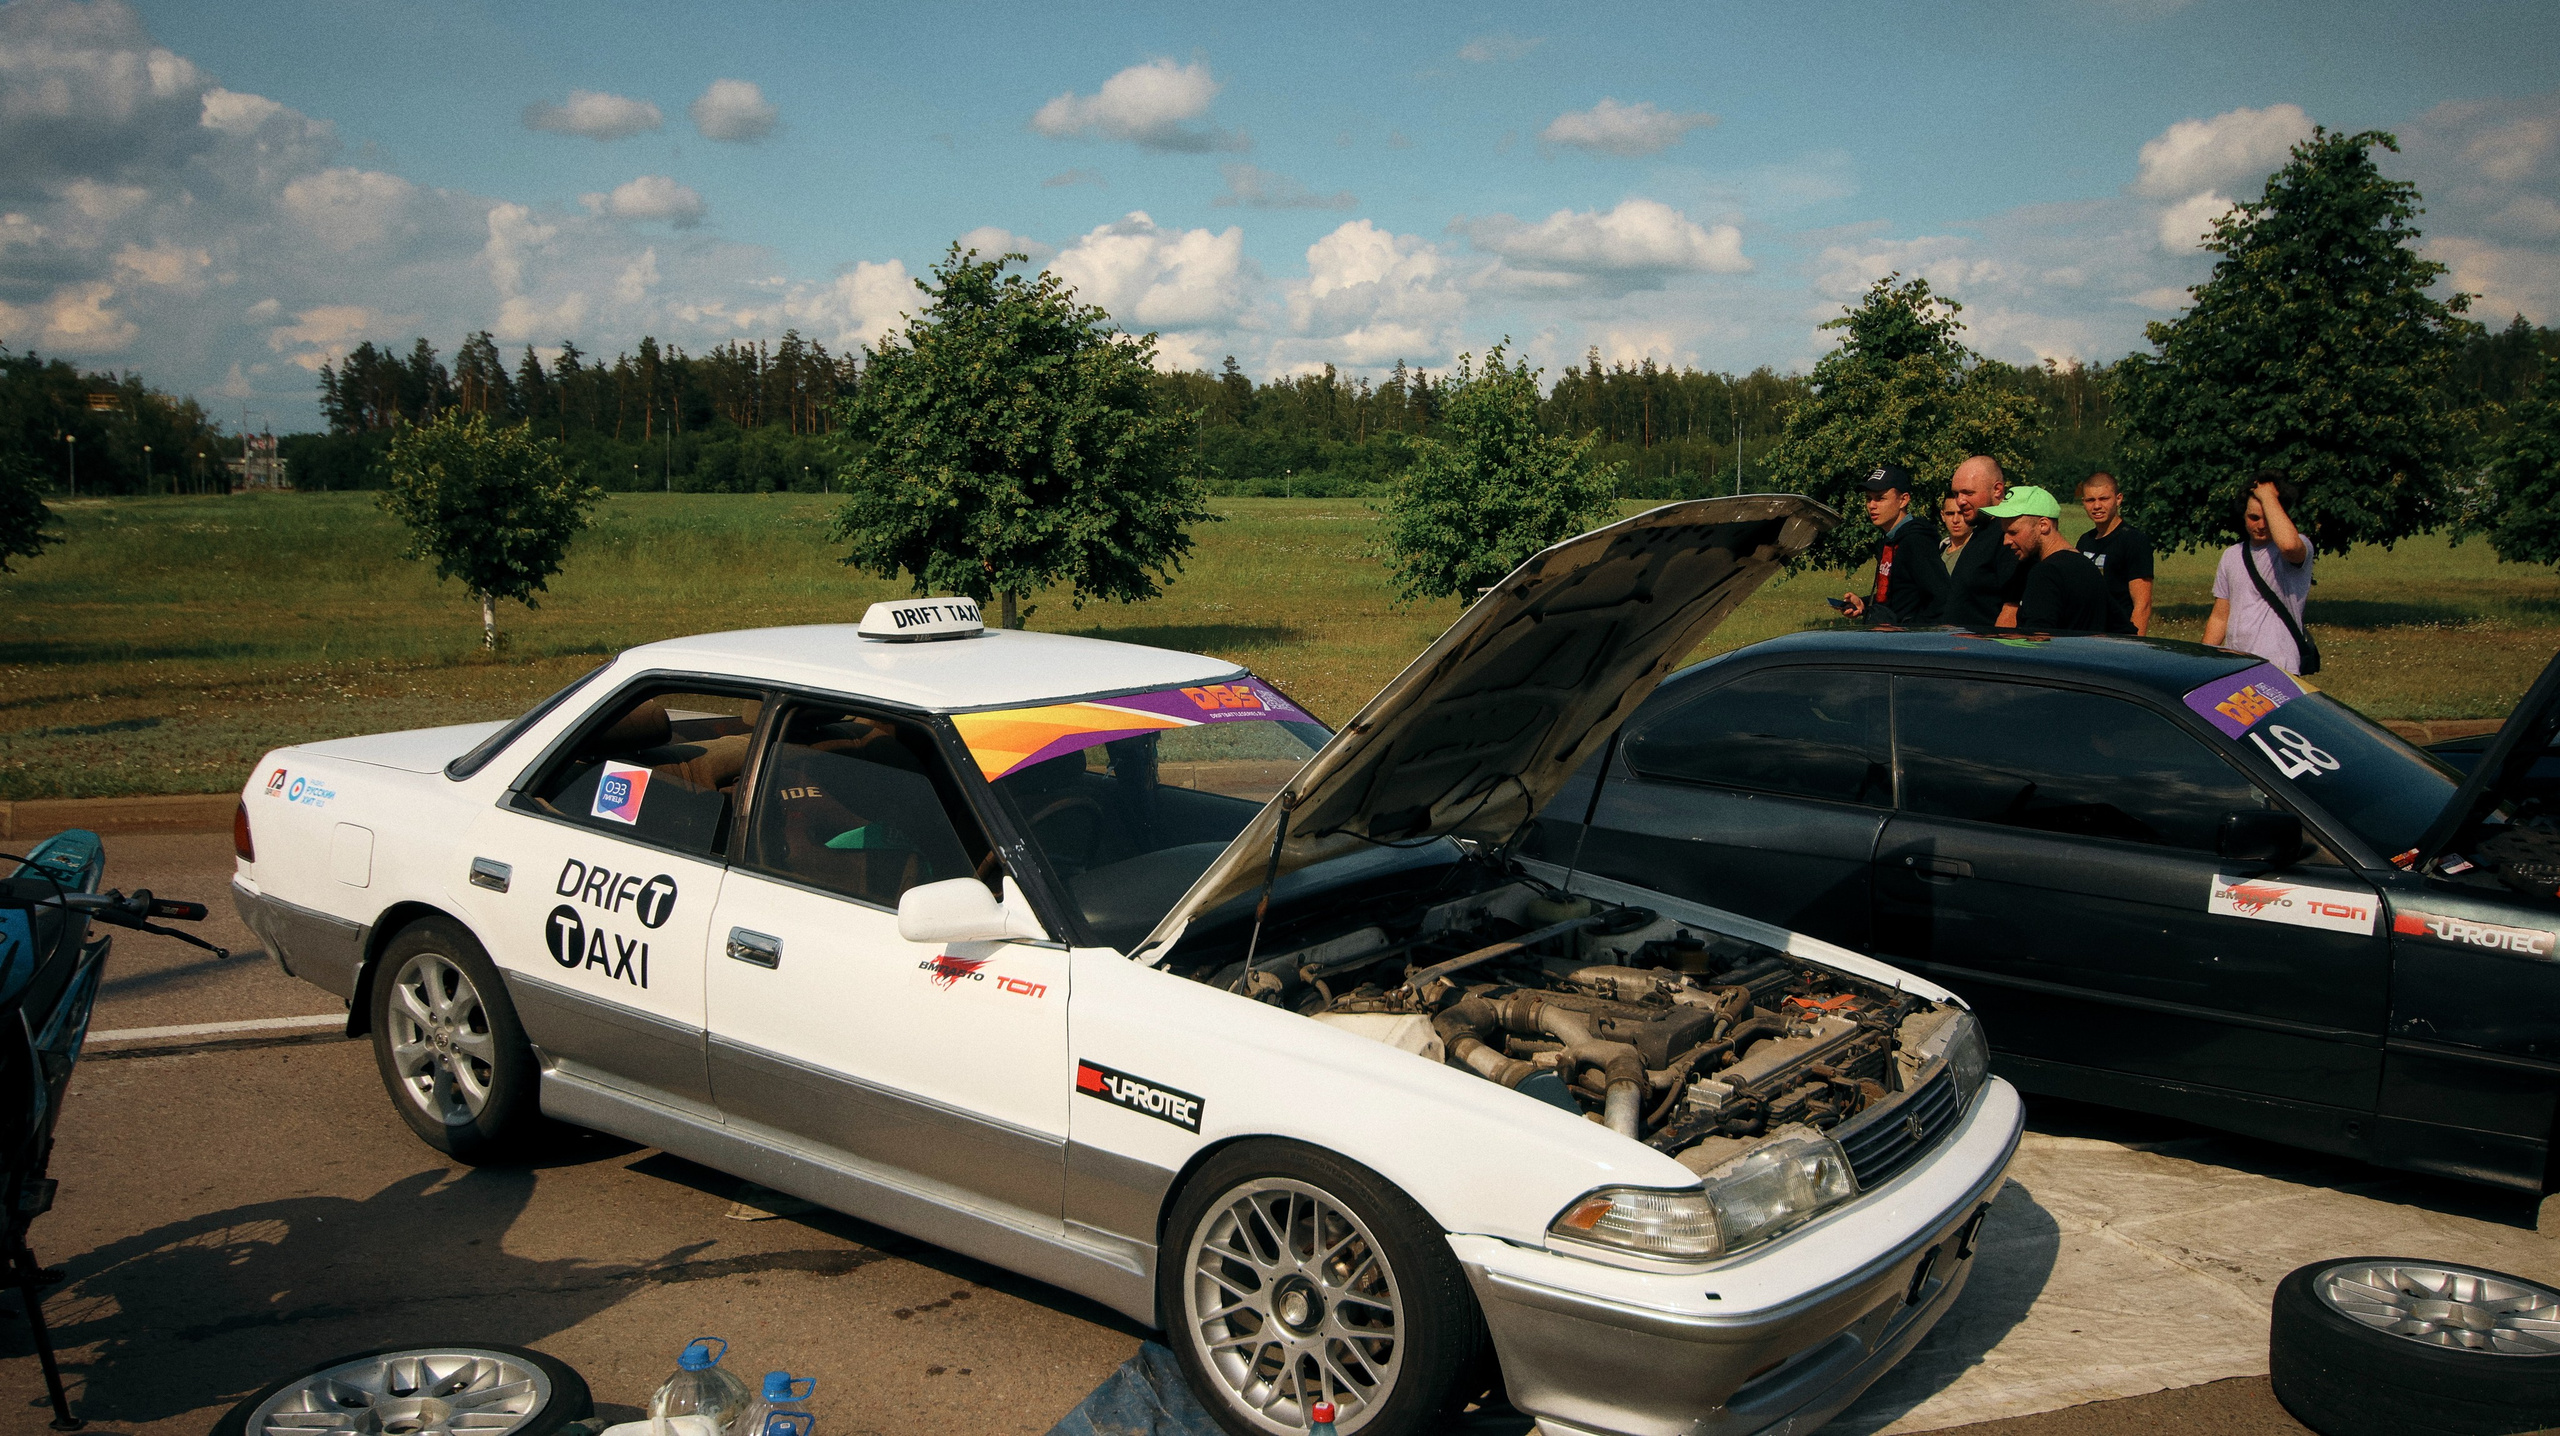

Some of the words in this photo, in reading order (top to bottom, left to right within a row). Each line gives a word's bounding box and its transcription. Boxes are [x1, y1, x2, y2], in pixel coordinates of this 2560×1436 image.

[892, 606, 943, 629] DRIFT
[944, 604, 982, 623] TAXI
[2248, 724, 2341, 780] 48
[556, 857, 678, 930] DRIFT
[545, 903, 649, 990] TAXI
